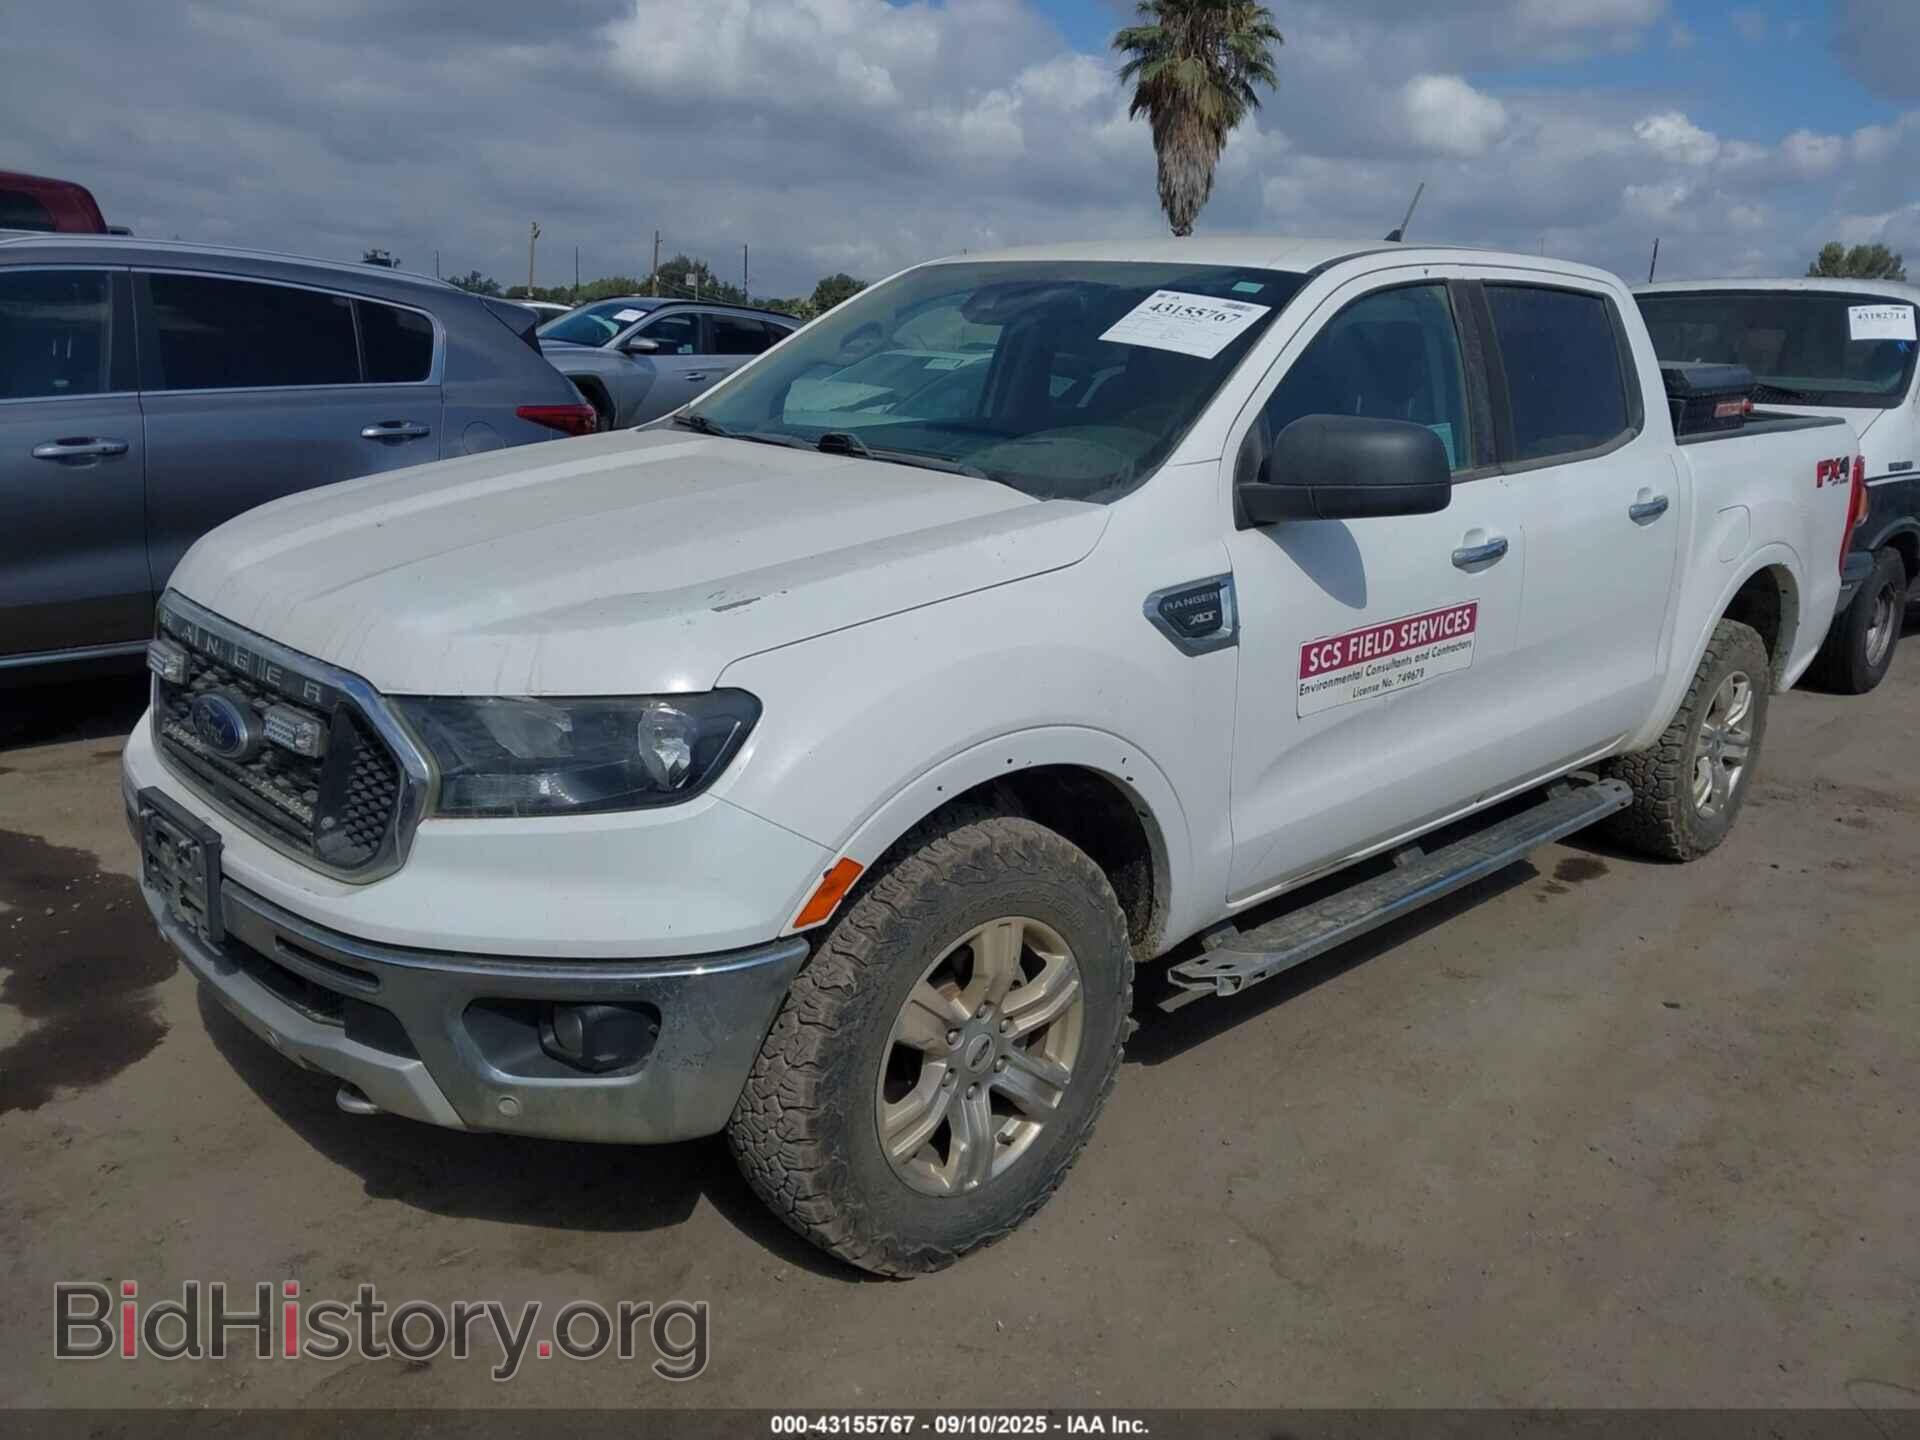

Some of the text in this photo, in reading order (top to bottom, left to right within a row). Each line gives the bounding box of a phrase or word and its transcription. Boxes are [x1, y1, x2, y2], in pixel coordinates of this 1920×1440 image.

[1150, 302, 1242, 323] 43155767
[1816, 456, 1849, 488] FX4
[1164, 591, 1219, 611] RANGER
[1308, 608, 1471, 672] SCS FIELD SERVICES
[1299, 638, 1472, 696] Environmental Consultants and Contractors
[1353, 681, 1380, 698] License
[1382, 678, 1395, 691] No.
